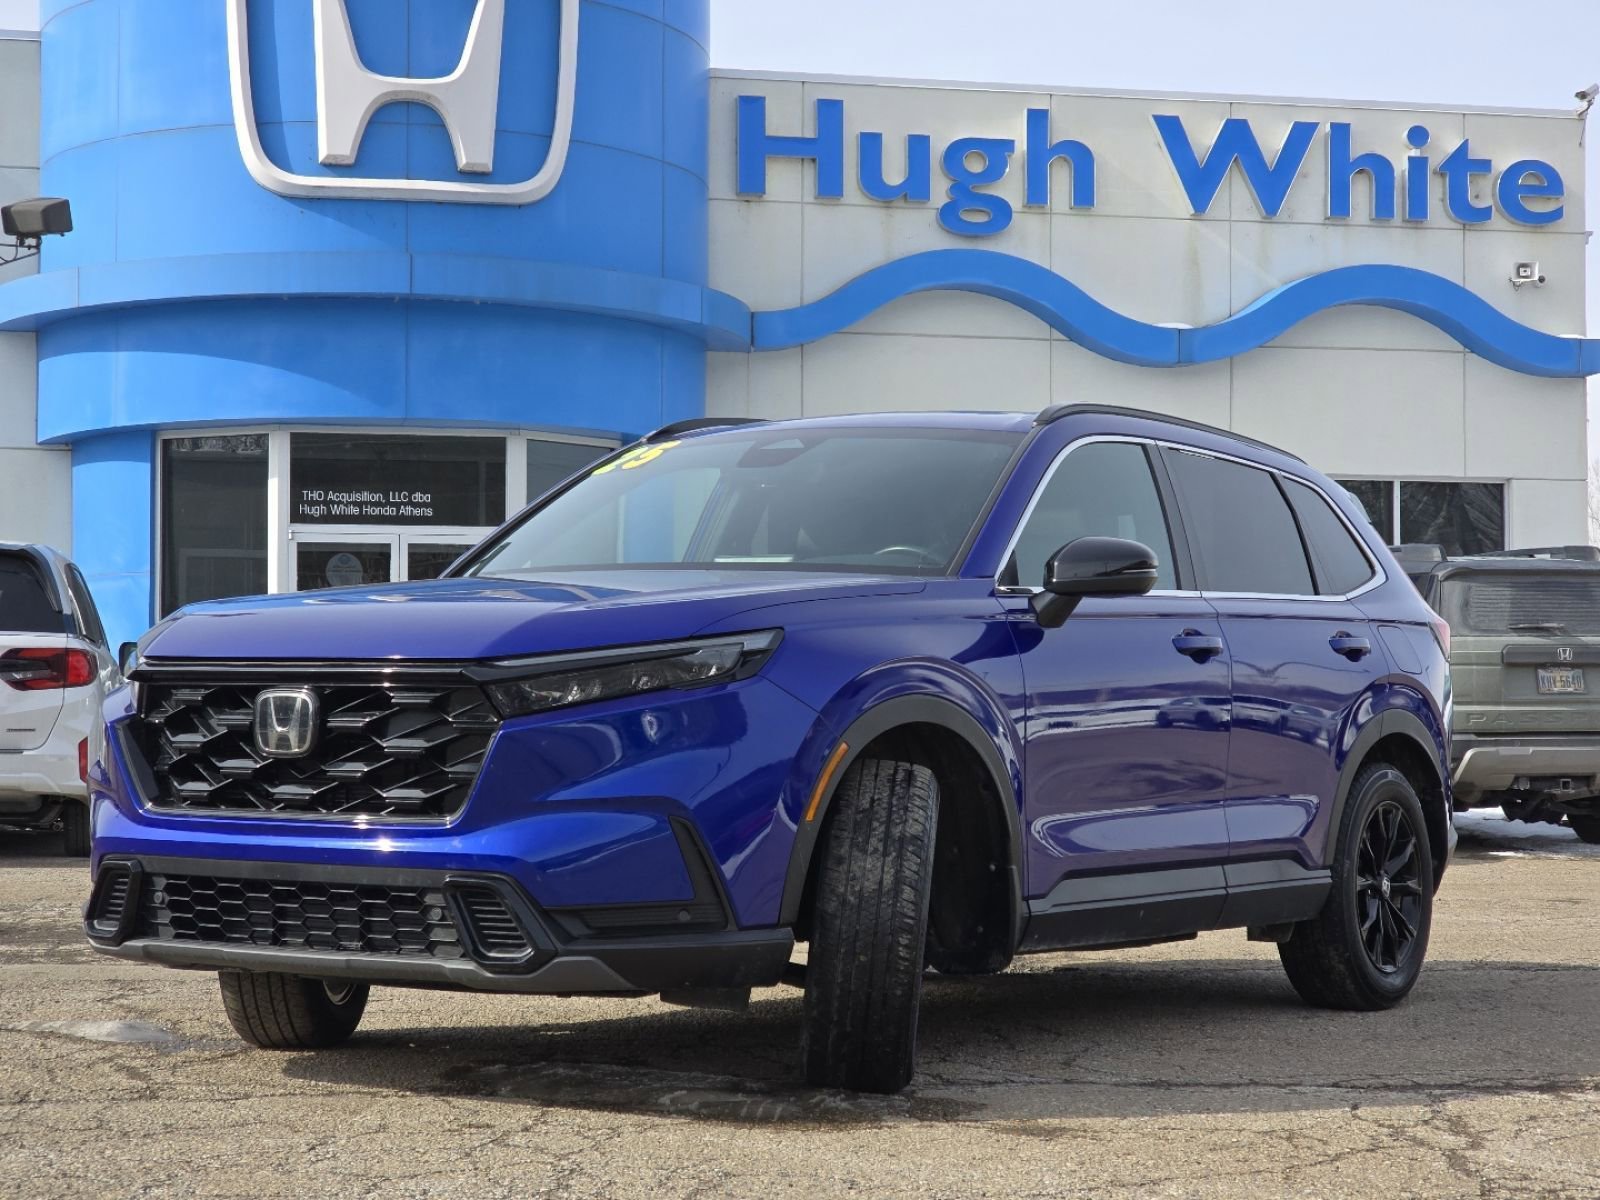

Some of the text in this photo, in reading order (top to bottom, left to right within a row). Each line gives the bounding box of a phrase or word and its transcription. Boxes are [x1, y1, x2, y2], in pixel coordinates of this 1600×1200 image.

[736, 94, 1565, 237] Hugh White
[302, 490, 431, 504] THO Acquisition, LLC dba
[299, 503, 433, 517] Hugh White Honda Athens
